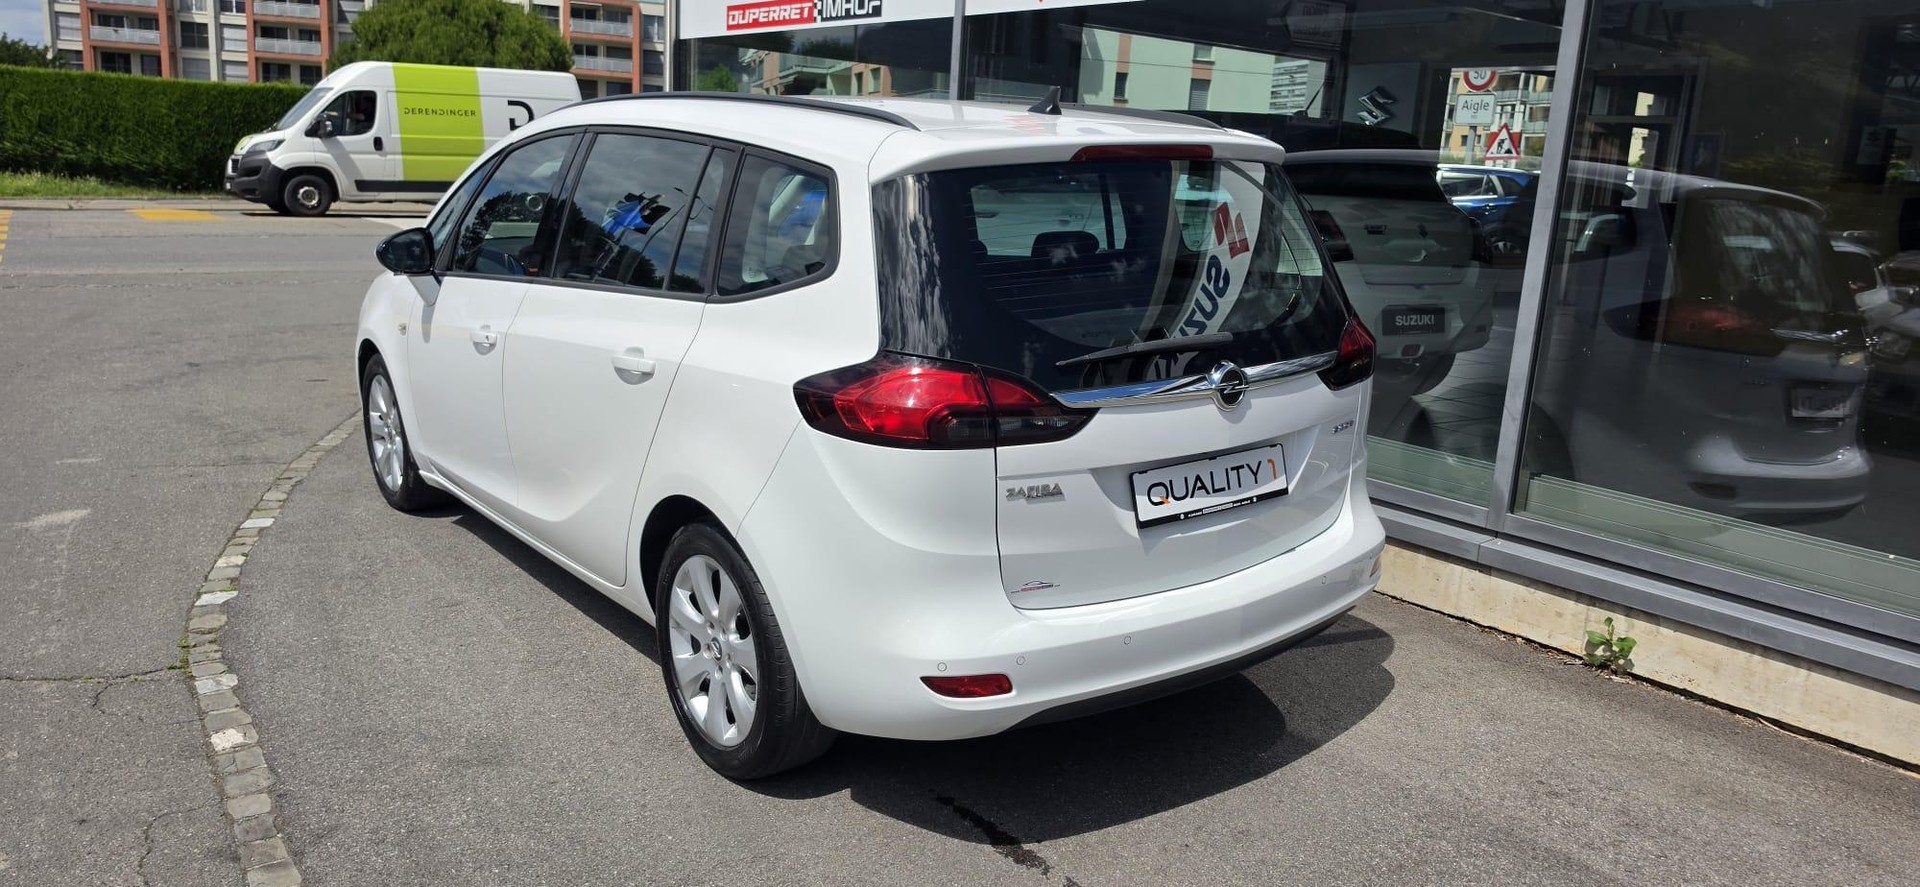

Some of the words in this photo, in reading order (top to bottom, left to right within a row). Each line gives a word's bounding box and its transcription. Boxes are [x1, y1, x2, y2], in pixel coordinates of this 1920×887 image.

[728, 3, 812, 25] DUPERRET
[1473, 70, 1487, 80] 50
[404, 107, 476, 116] DERENDINGER
[1461, 99, 1490, 113] Aigle
[1395, 314, 1434, 327] SUZUKI
[1147, 460, 1262, 506] QUALITY
[1267, 458, 1277, 480] 1
